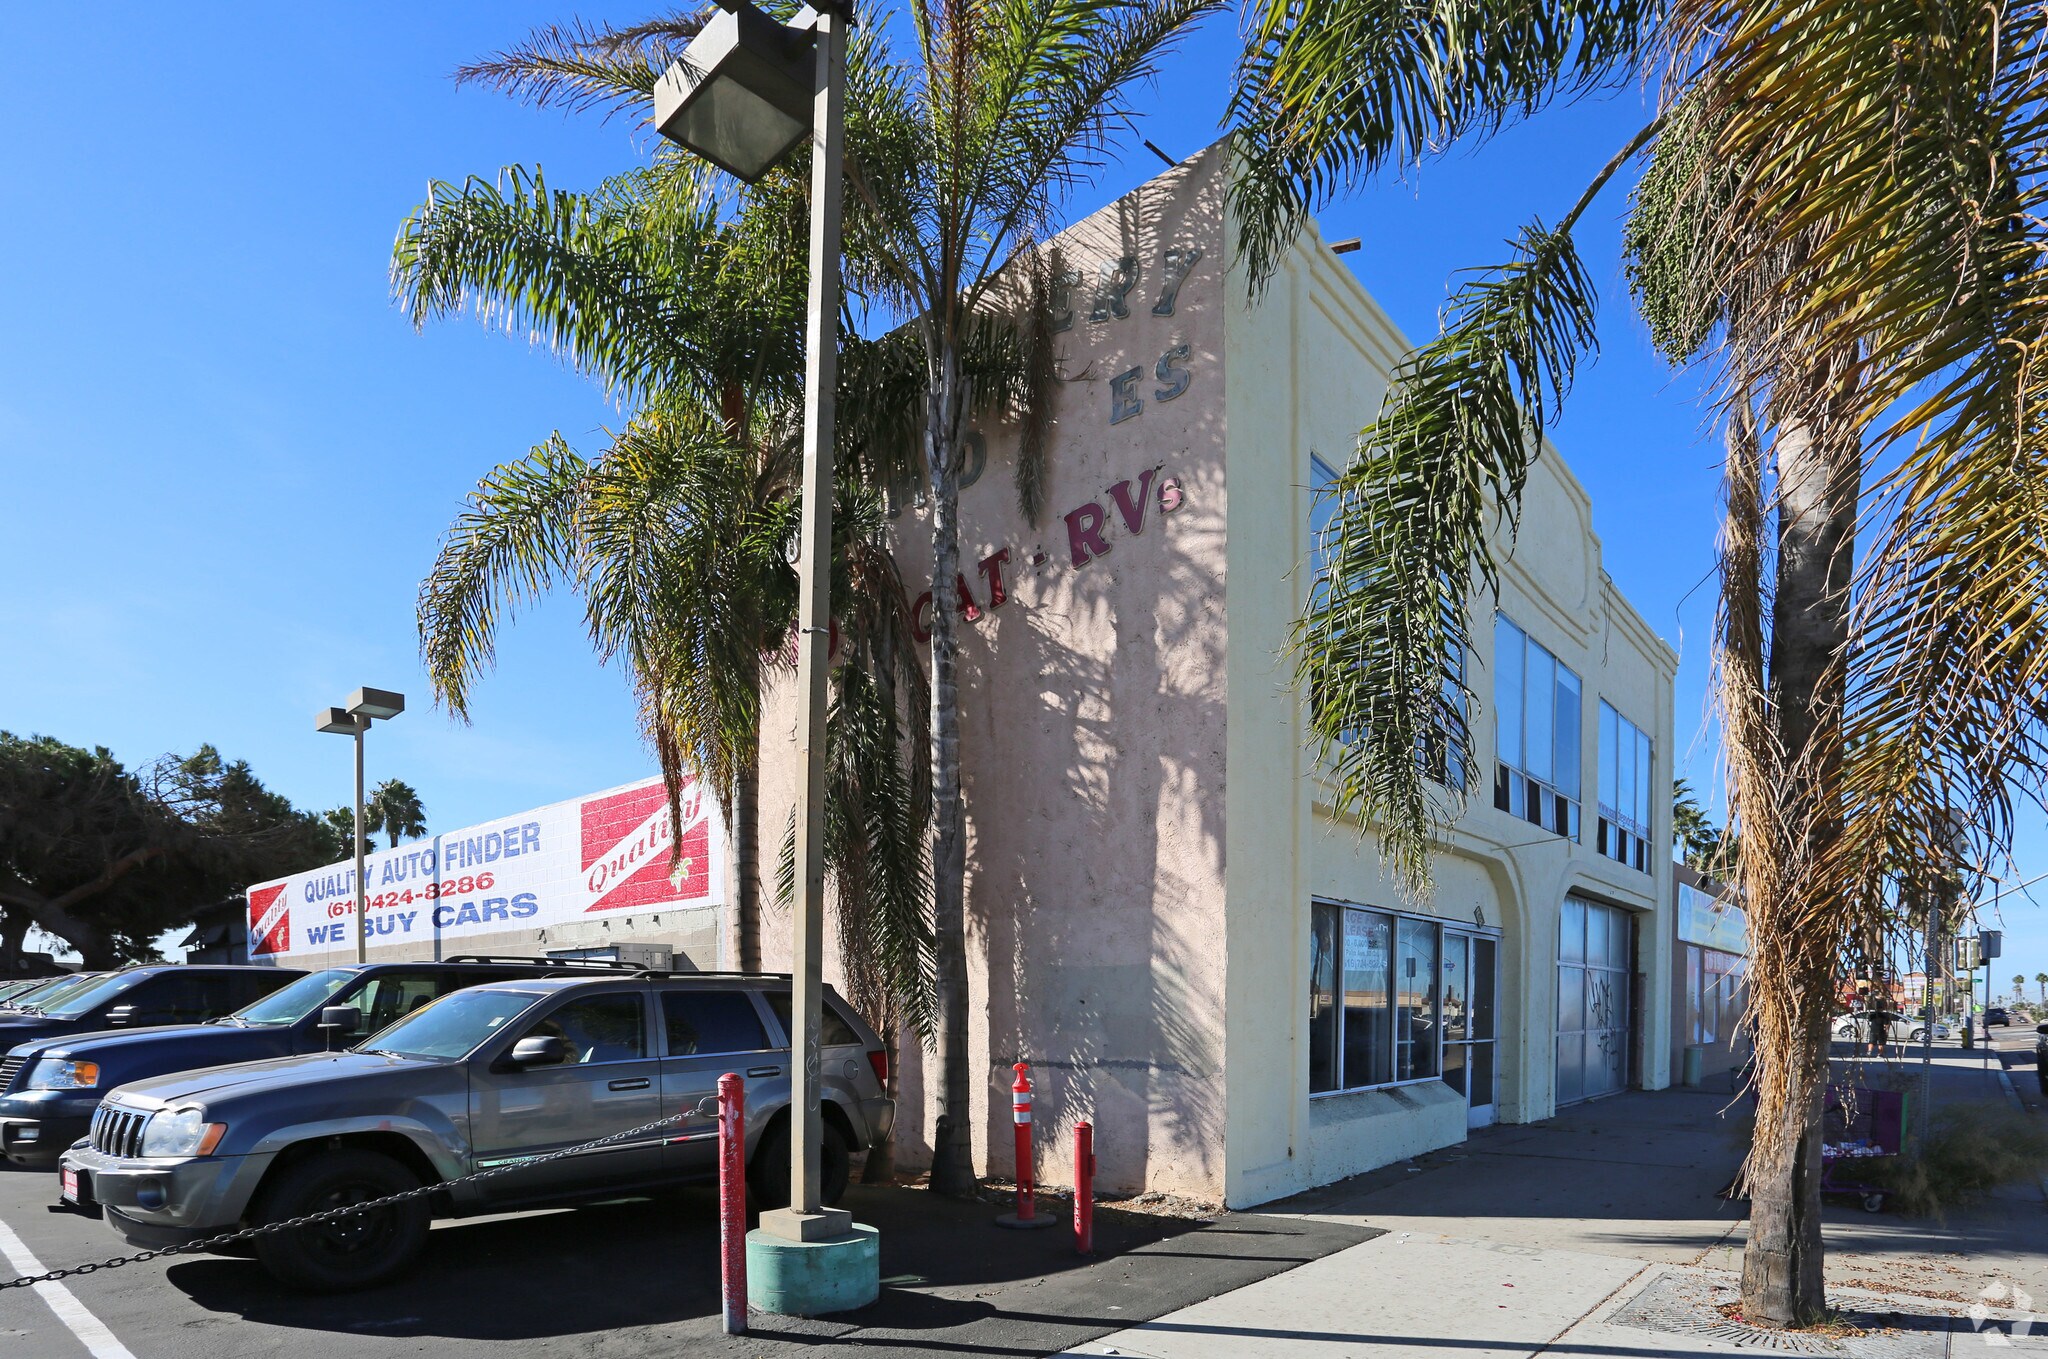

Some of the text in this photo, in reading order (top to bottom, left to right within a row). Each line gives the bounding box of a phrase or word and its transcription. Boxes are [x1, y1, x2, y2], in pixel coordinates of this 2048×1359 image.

[381, 848, 436, 885] AUTO
[445, 821, 541, 871] FINDER
[588, 790, 702, 893] Qualiy
[252, 893, 287, 945] Quality
[307, 923, 345, 945] WE
[432, 893, 538, 928] CARS
